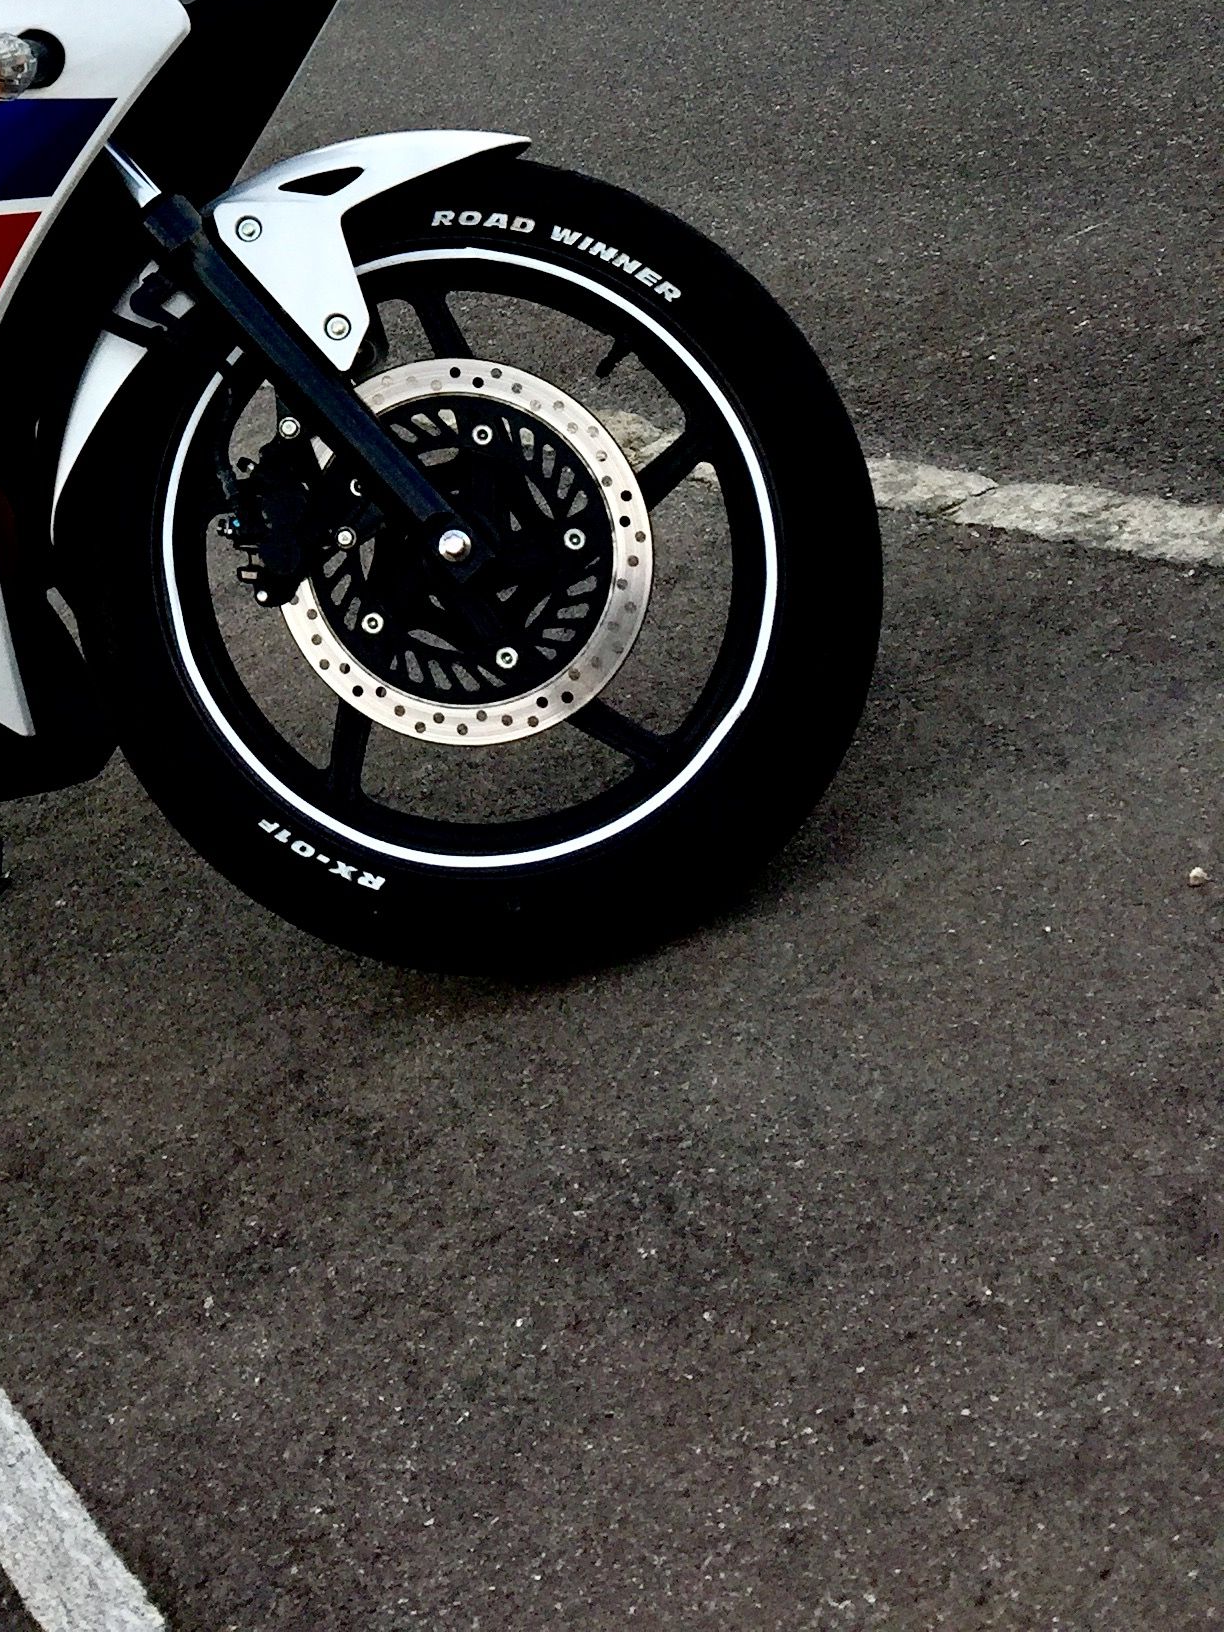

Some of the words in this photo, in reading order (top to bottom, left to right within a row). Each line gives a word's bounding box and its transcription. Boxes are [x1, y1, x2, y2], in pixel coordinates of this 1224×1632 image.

[431, 210, 536, 234] ROAD
[550, 225, 682, 303] WINNER
[257, 818, 386, 891] RX-01F
